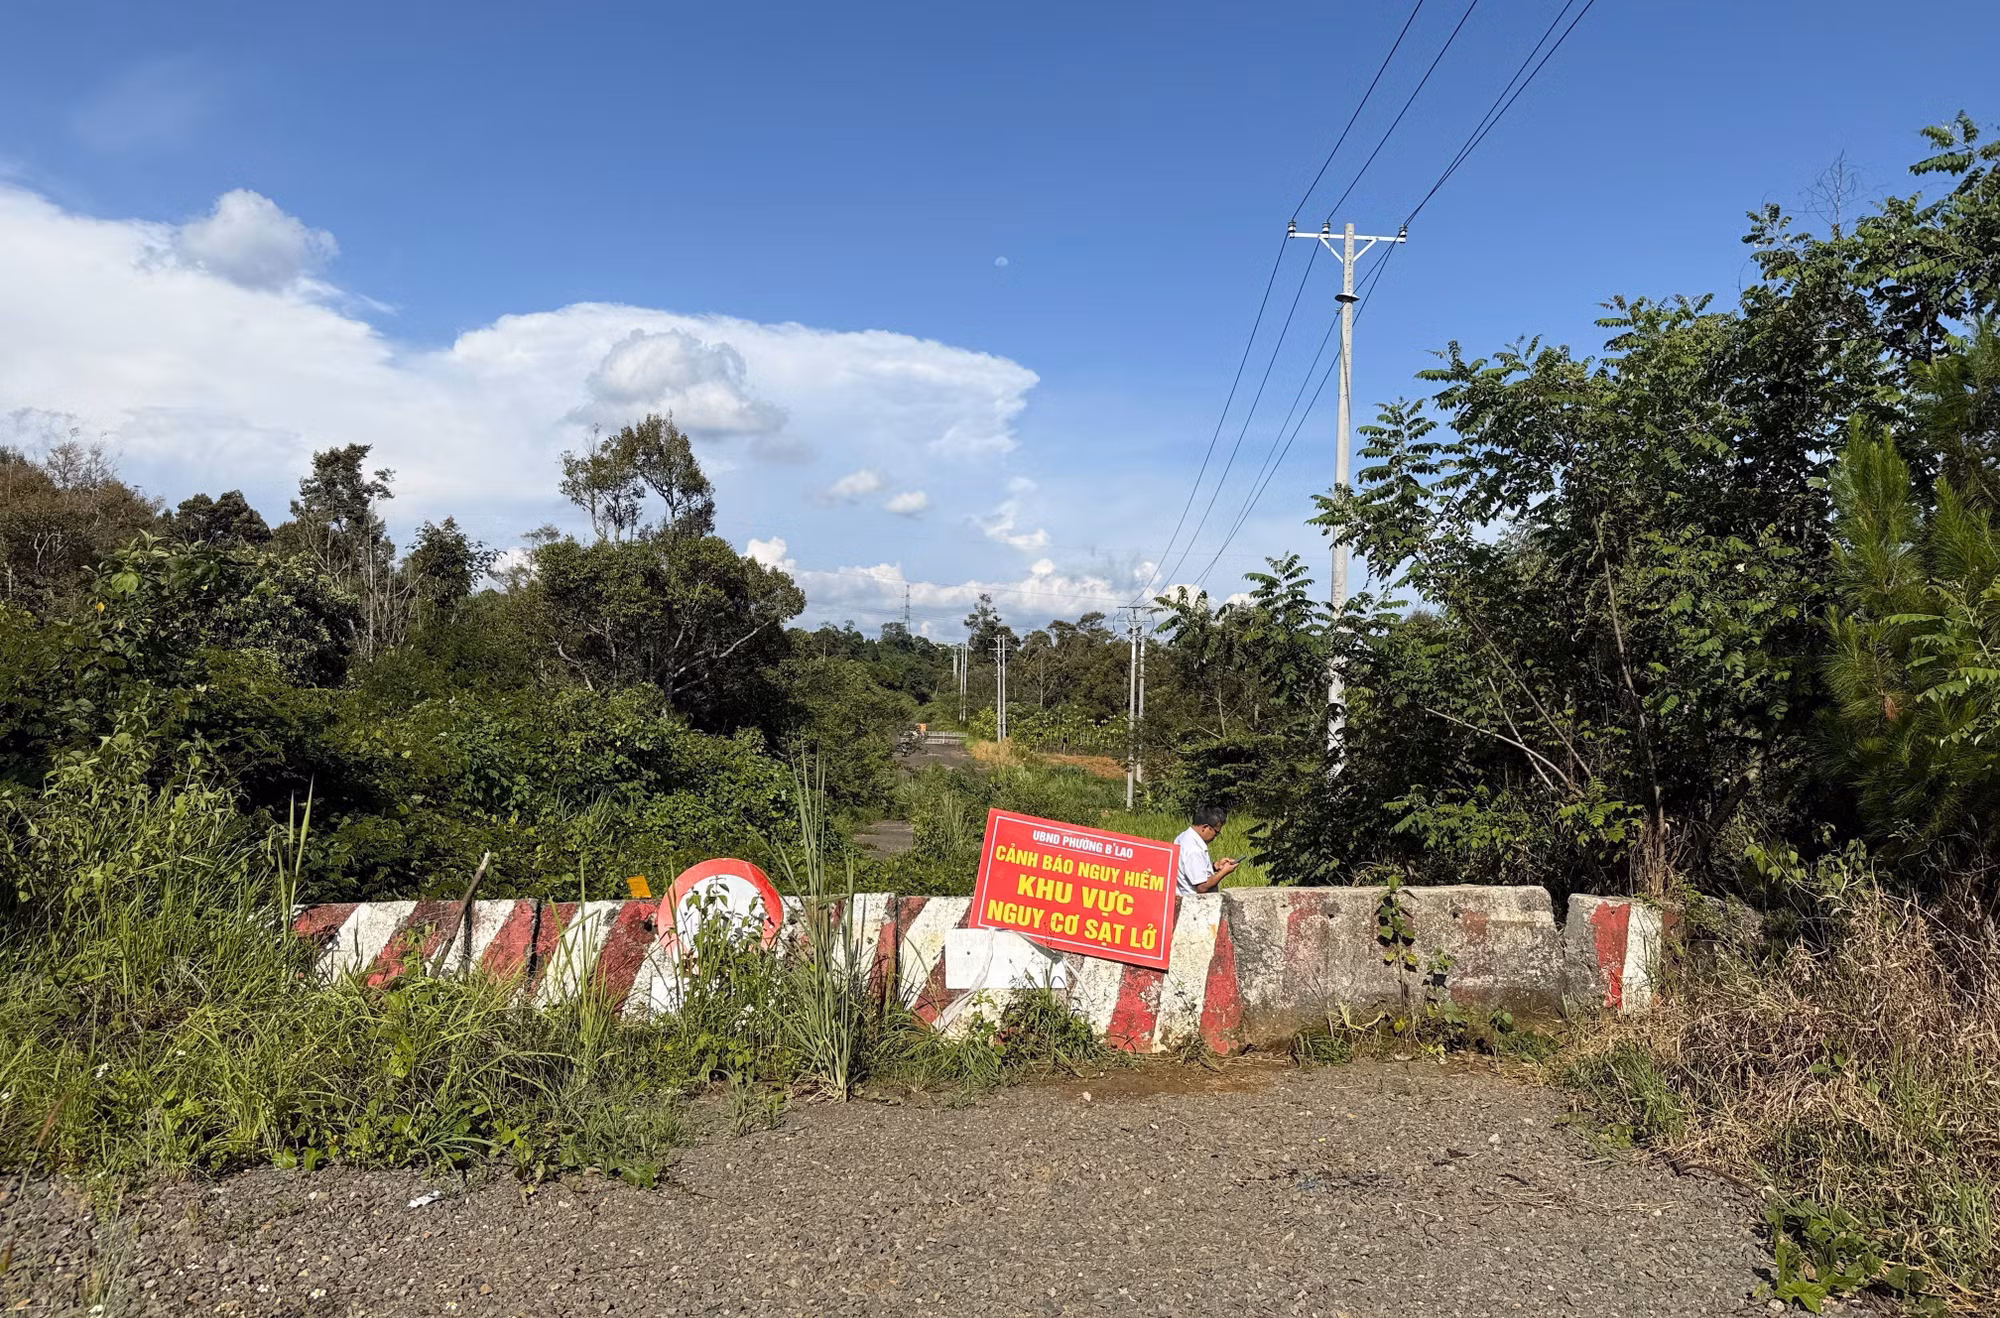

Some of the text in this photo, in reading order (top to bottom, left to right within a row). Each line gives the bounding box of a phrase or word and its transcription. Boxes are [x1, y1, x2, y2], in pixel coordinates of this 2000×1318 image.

[1033, 829, 1060, 846] UBND
[1062, 834, 1103, 854] PHƯỜNG
[995, 842, 1165, 892] CẢNH BÁO NGUY HIỂM
[1017, 873, 1135, 917] KHU VỰC
[987, 899, 1158, 951] NGUY CƠ SẠT LỞ
